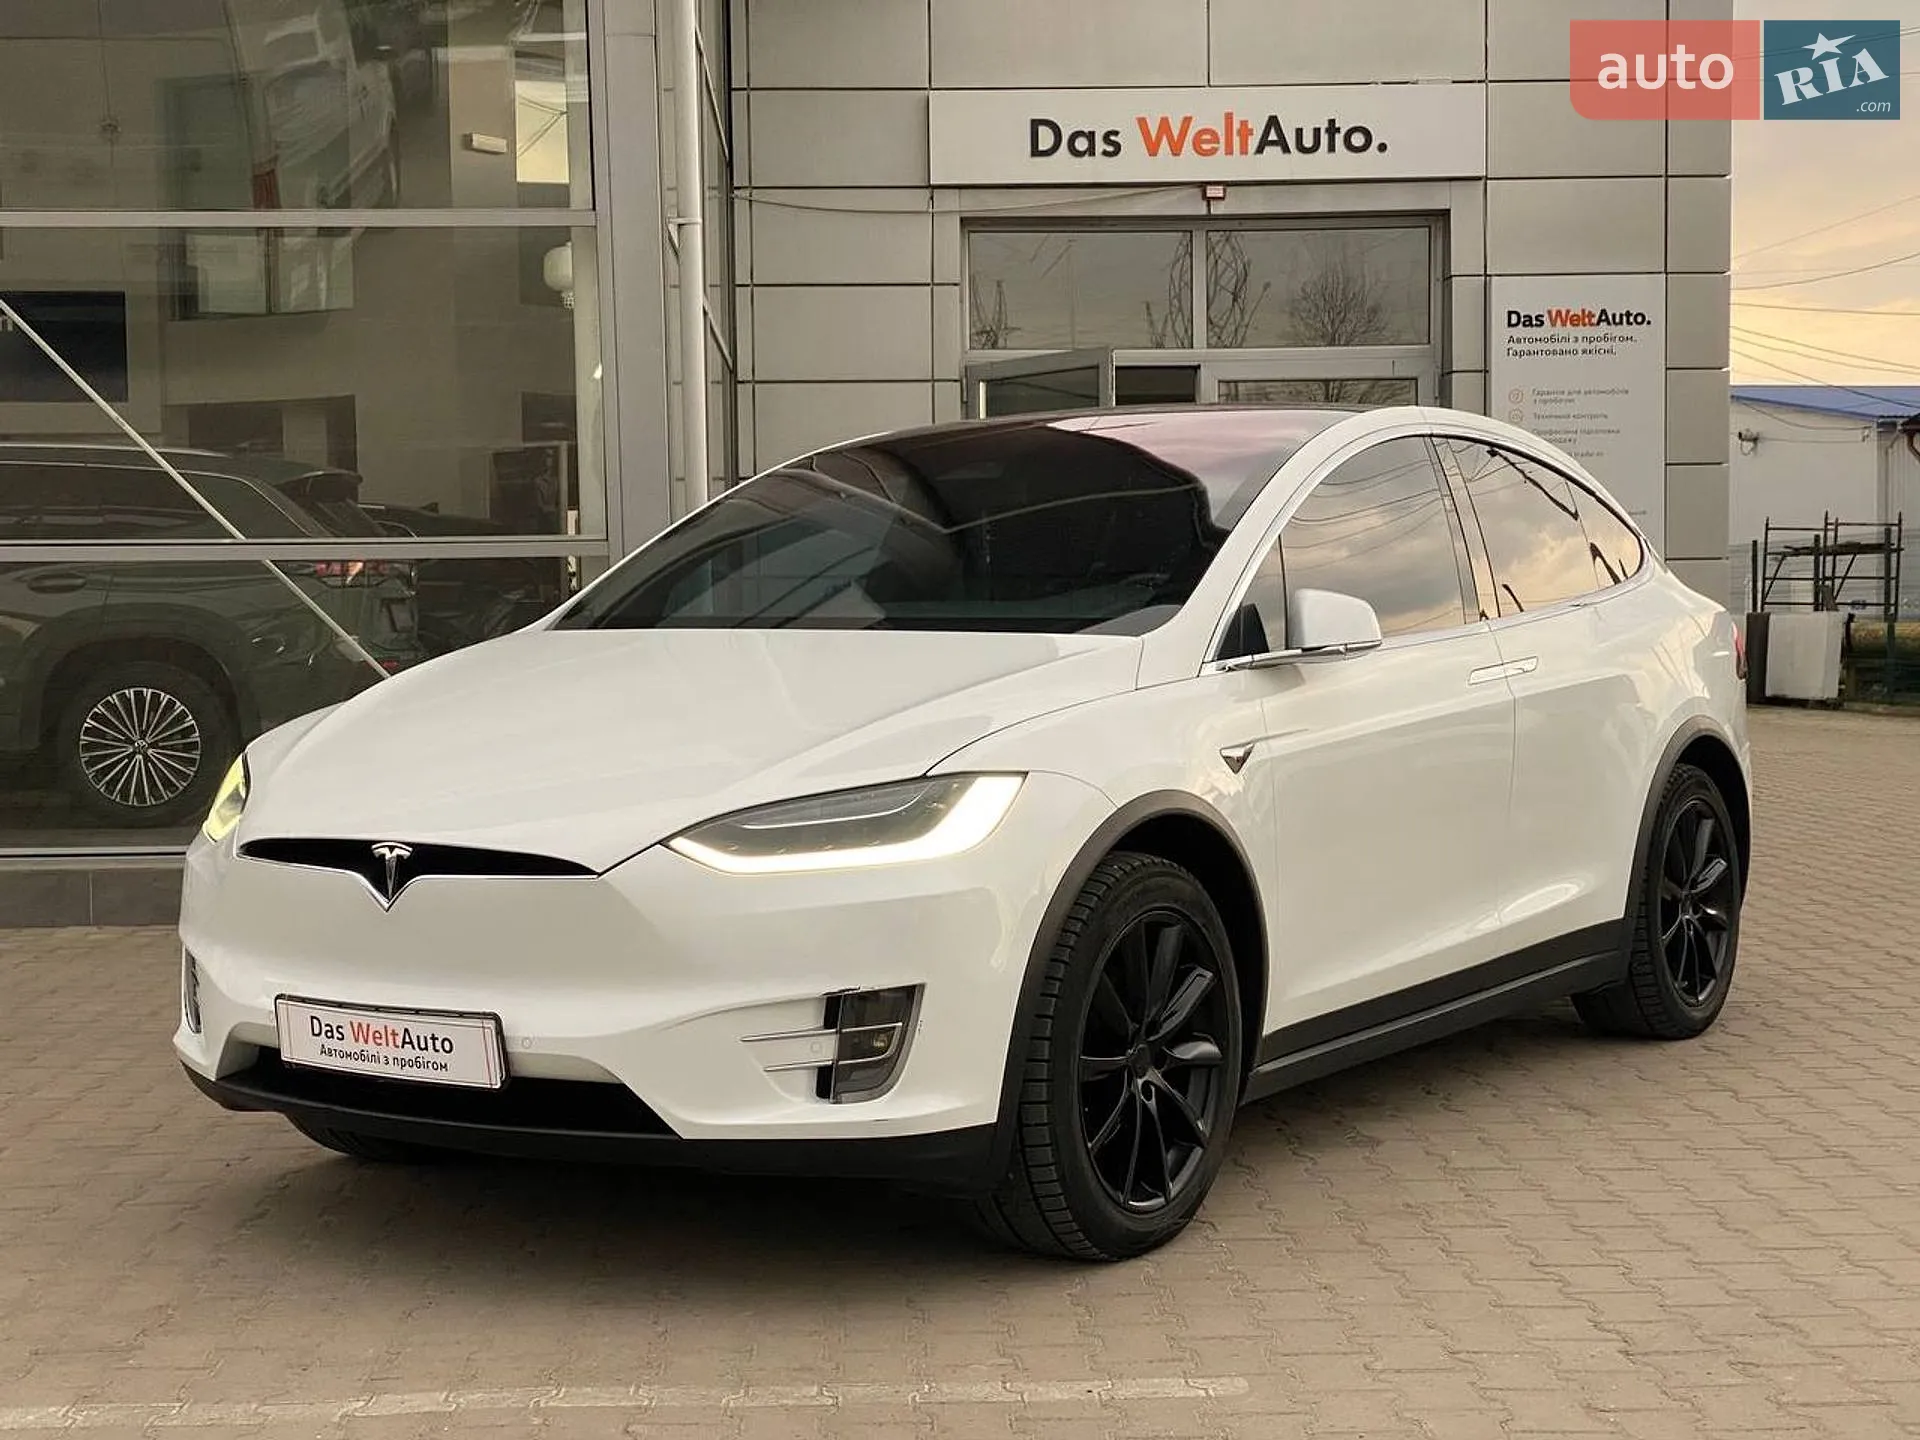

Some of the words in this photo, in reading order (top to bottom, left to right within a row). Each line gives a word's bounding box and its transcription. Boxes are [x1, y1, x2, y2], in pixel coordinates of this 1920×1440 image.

[1029, 117, 1122, 158] Das
[1136, 111, 1388, 157] WeltAuto.
[1507, 310, 1545, 328] Das
[1547, 308, 1652, 328] WeltAuto.
[1507, 333, 1571, 344] Автомобілі
[1506, 347, 1578, 358] Гарантовано
[310, 1015, 345, 1041] Das
[350, 1020, 453, 1054] WeltAuto
[320, 1044, 381, 1064] Автомобілі
[384, 1055, 390, 1065] з
[392, 1054, 448, 1072] пробігом
